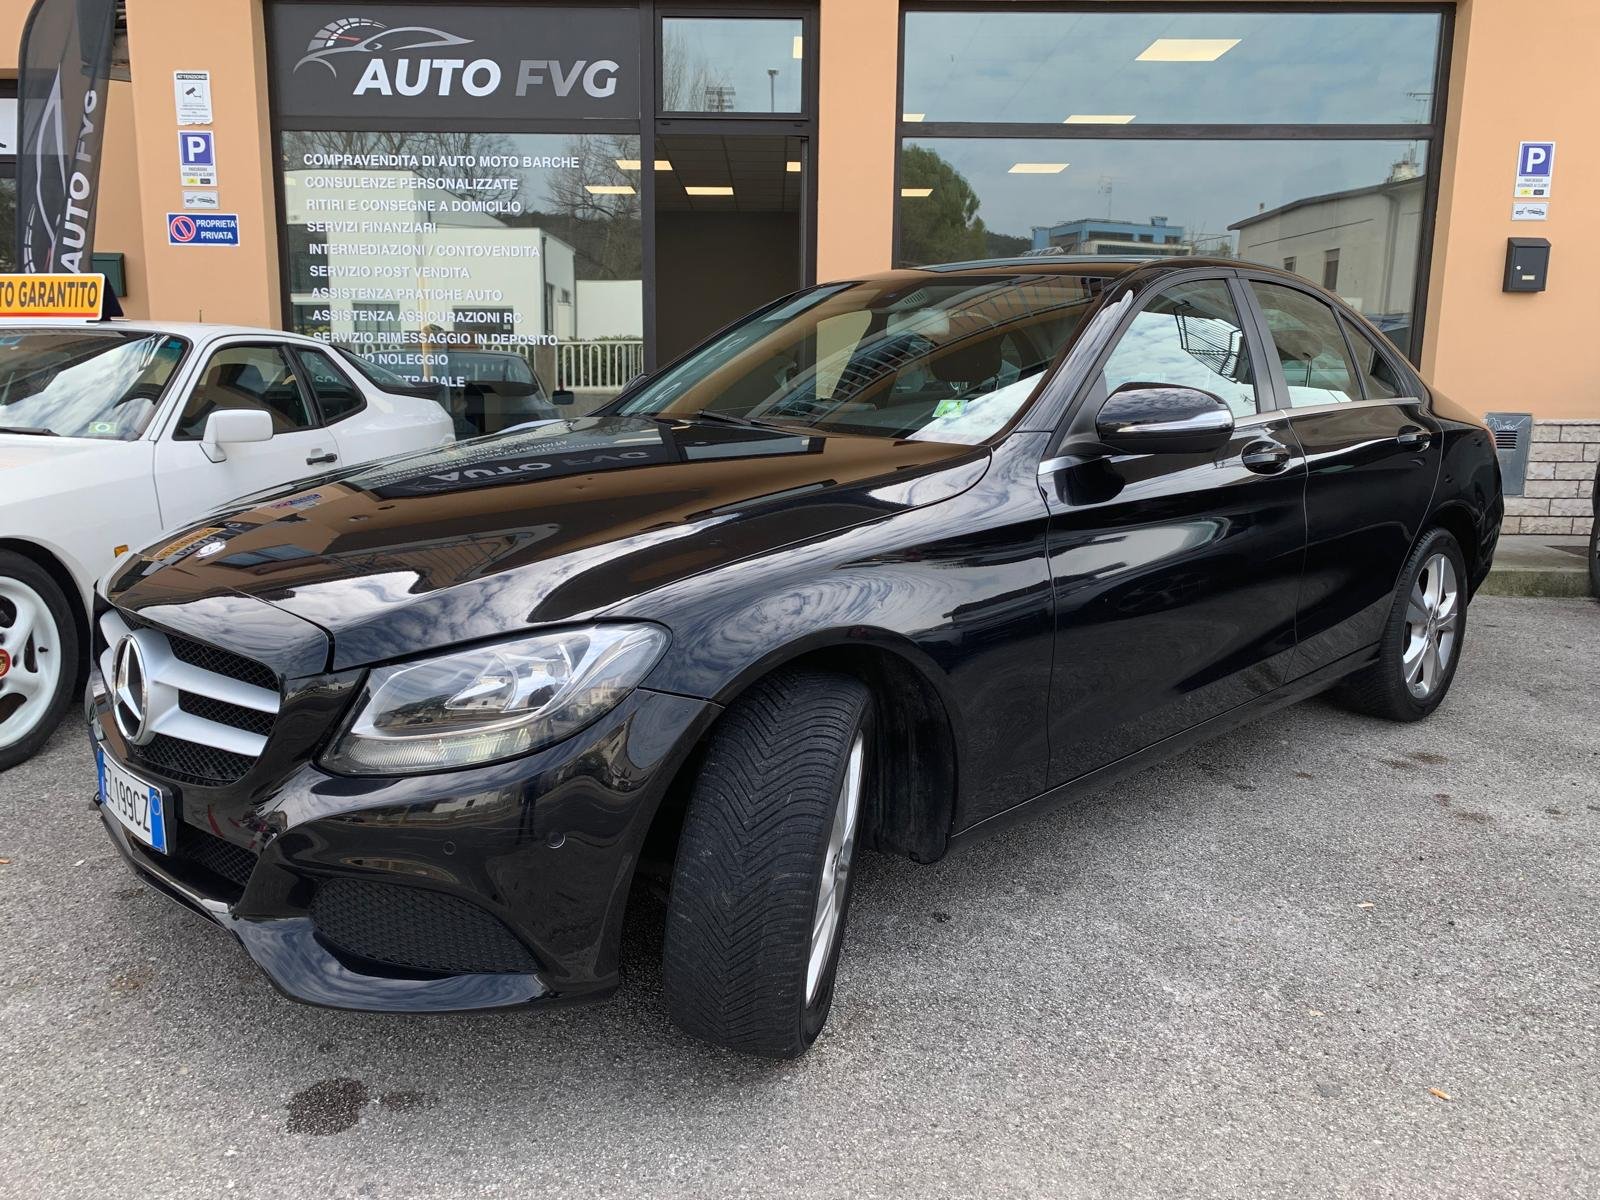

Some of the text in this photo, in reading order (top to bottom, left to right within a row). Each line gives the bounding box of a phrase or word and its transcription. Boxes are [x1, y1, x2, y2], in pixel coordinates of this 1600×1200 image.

[352, 58, 620, 98] AUTO FVG
[187, 136, 206, 162] P
[303, 153, 580, 169] COMPRAVENDITA DI AUTO MOTO BARCHE
[1526, 147, 1546, 173] P
[304, 176, 519, 190] CONSULENZE PERSONALIZZATE
[306, 199, 521, 213] RITIRI E CONSEGNE A DOMICILIO
[60, 171, 91, 274] AUTO
[307, 222, 437, 233] SERVIZI FINANZIARI
[200, 231, 233, 240] PRIVATA
[309, 244, 425, 256] INTERMEDIAZIONI
[436, 245, 540, 257] CONTOVENDITA
[310, 265, 470, 278] SERVIZIO POST VENDITA
[18, 281, 98, 308] GARANTITO
[312, 288, 503, 301] ASSISTENZA PRATICHE AUTO
[312, 310, 522, 324] ASSISTENZA ASSICURAZIONI RC
[313, 332, 558, 346] SERVIZIO RIMESSAGGIO IN DEPOSITO
[378, 353, 449, 365] NOLEGGIO
